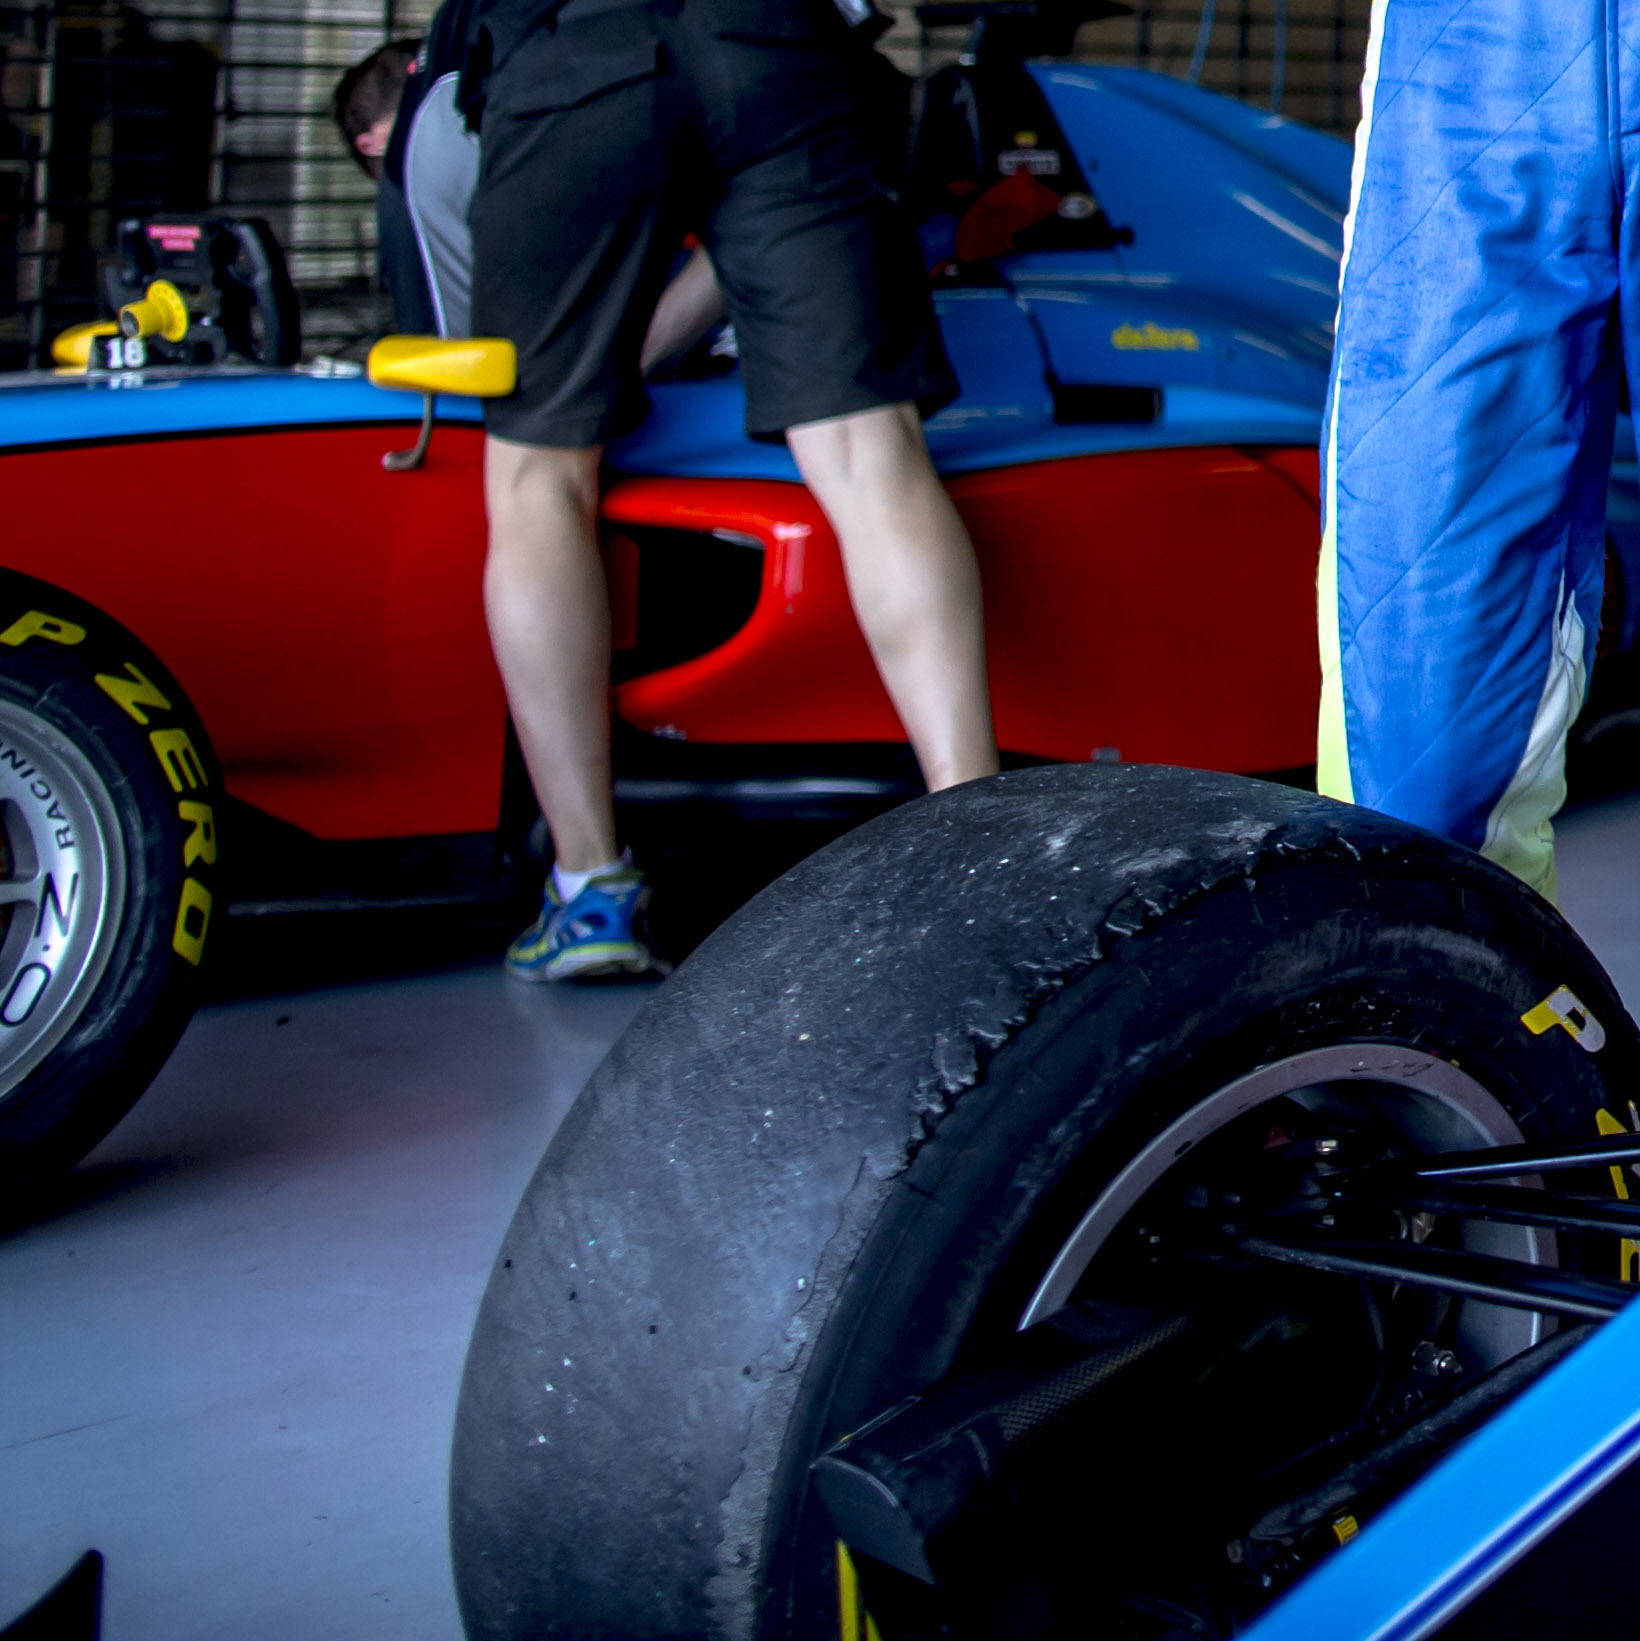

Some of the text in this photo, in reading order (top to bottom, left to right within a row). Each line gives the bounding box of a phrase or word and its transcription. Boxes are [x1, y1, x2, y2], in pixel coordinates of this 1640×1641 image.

[106, 336, 145, 369] 18
[0, 610, 217, 966] P ZERO
[0, 741, 76, 850] RACIN
[1520, 984, 1605, 1052] P
